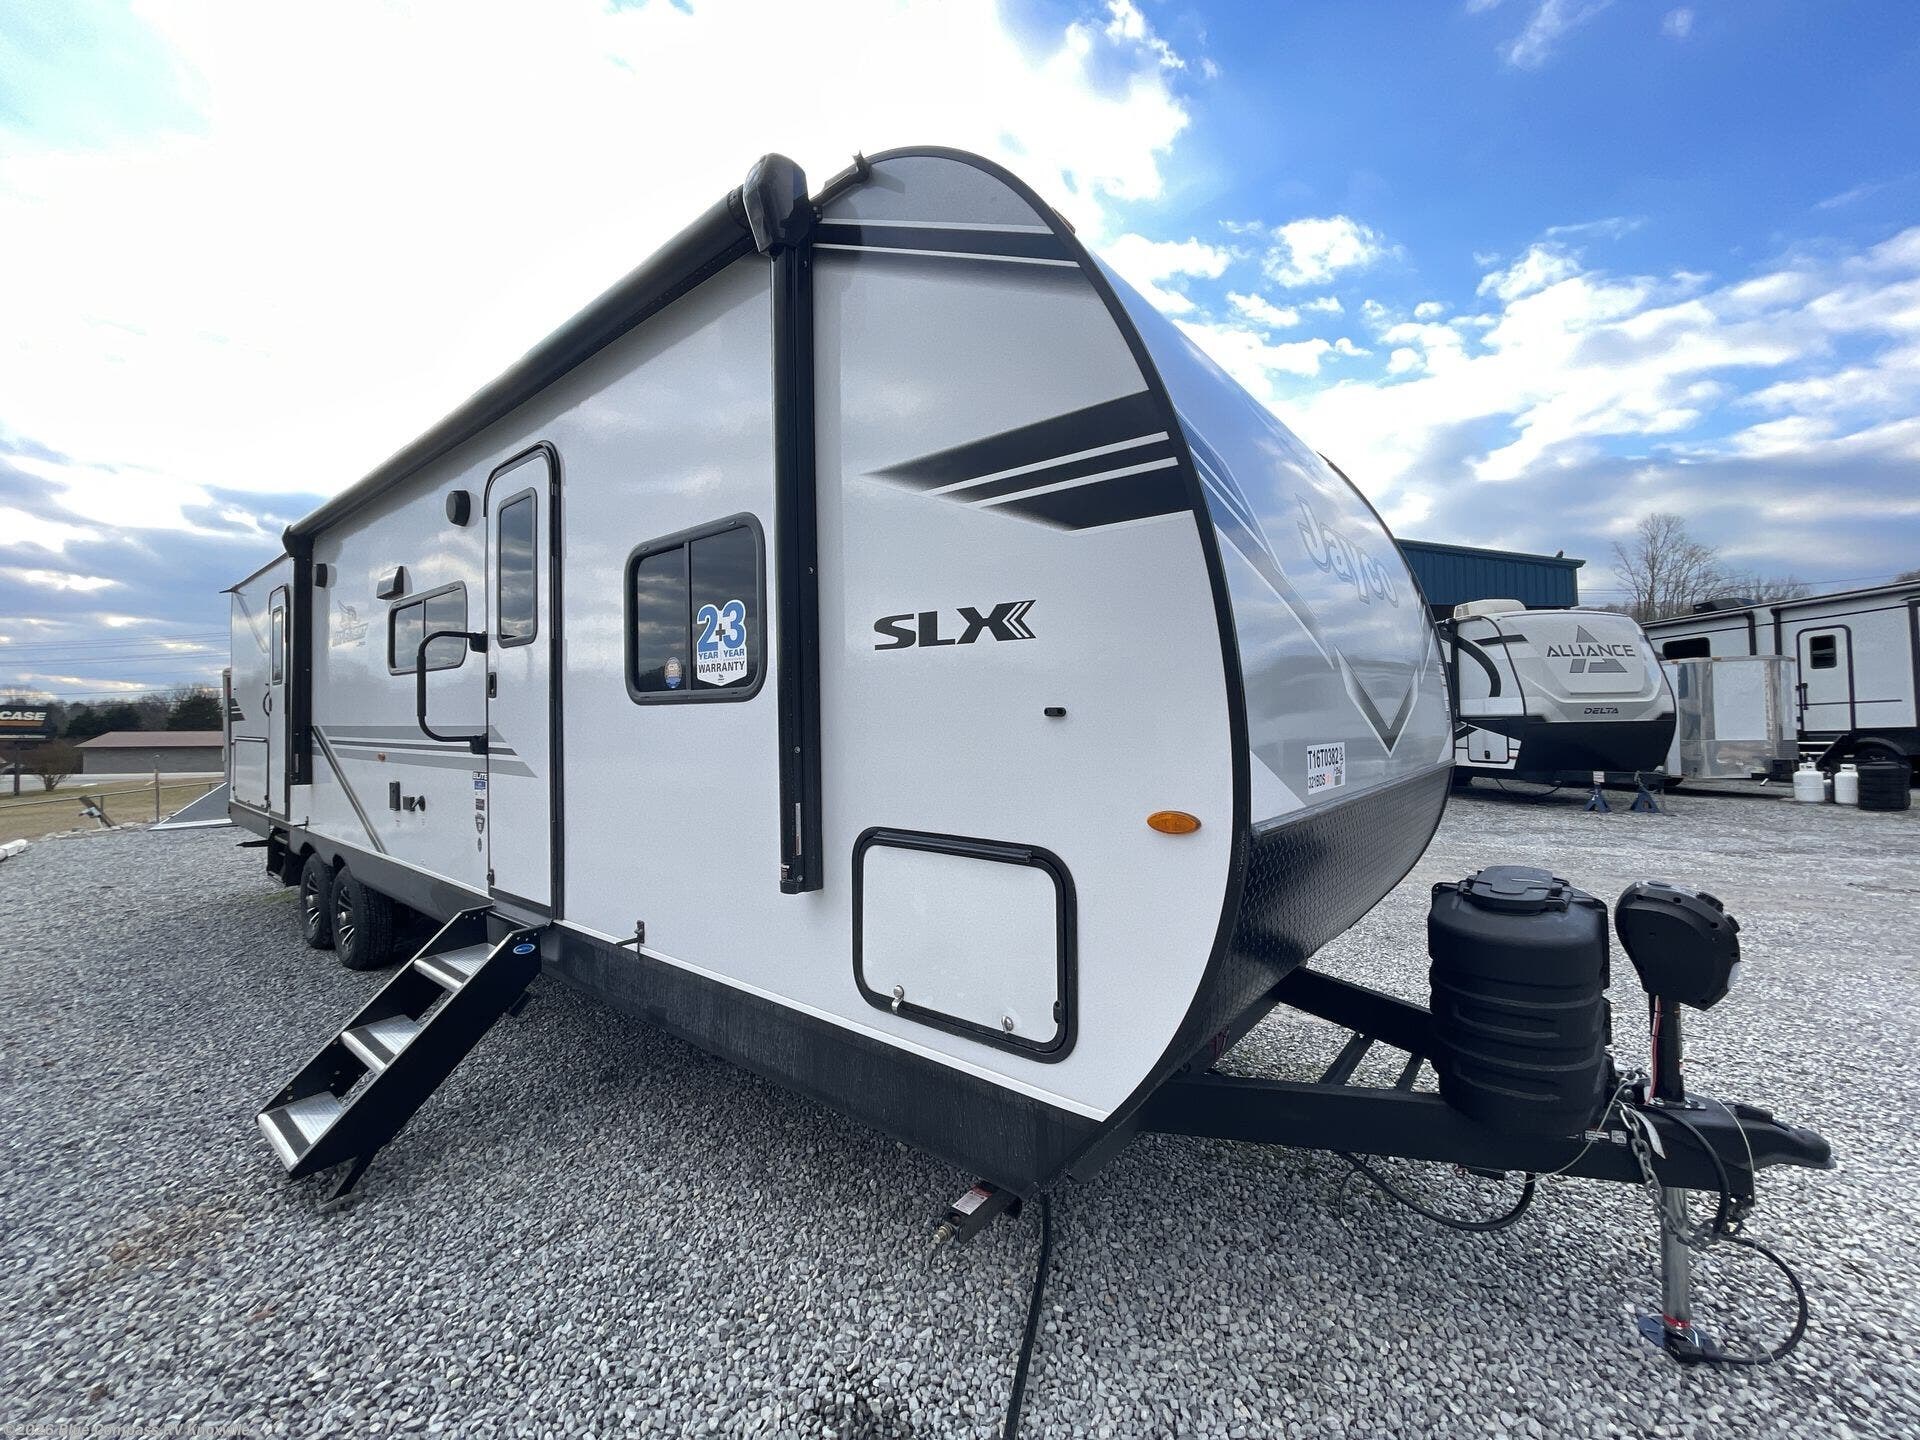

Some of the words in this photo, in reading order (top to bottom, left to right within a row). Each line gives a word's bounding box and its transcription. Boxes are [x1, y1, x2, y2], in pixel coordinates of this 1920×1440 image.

[874, 599, 1036, 651] SLX
[699, 651, 718, 660] YEAR
[723, 648, 745, 658] YEAR
[1546, 644, 1636, 657] ALLIANCE
[698, 660, 745, 674] WARRANTY
[1583, 707, 1619, 715] DELTA
